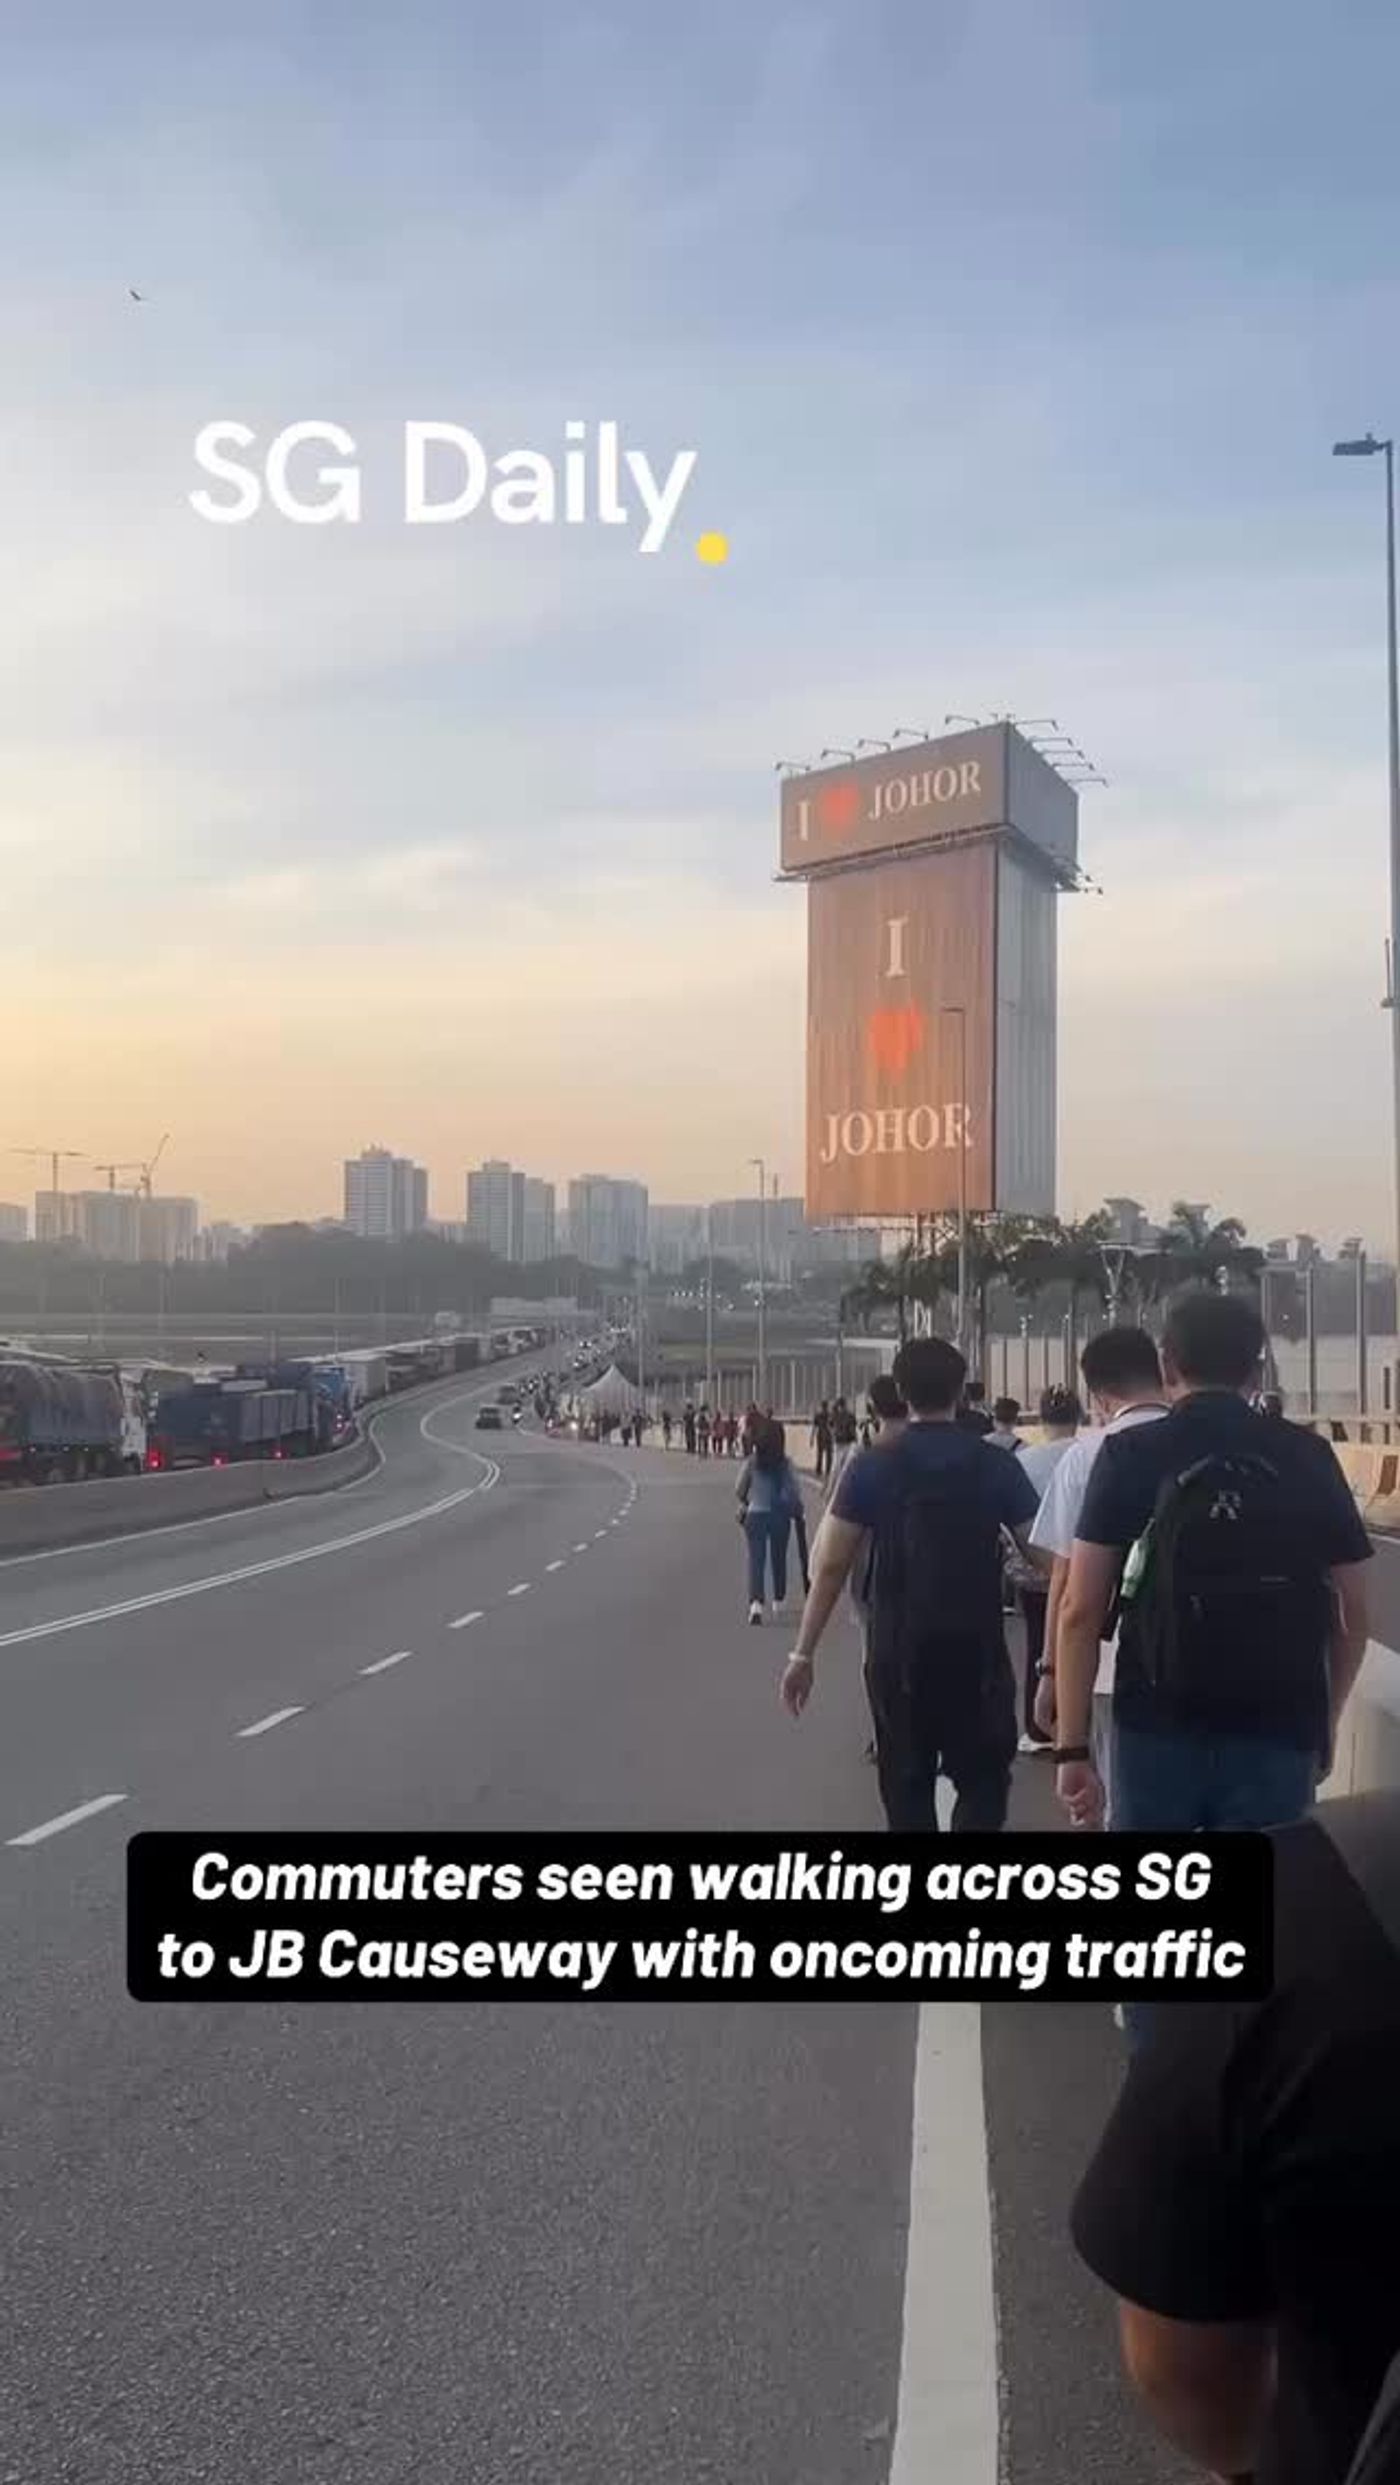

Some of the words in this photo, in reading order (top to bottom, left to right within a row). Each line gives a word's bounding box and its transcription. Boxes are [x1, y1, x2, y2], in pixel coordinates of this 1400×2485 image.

[798, 800, 809, 842] I
[868, 760, 982, 820] JOHOR
[885, 916, 909, 979] I
[820, 1102, 973, 1162] JOHOR
